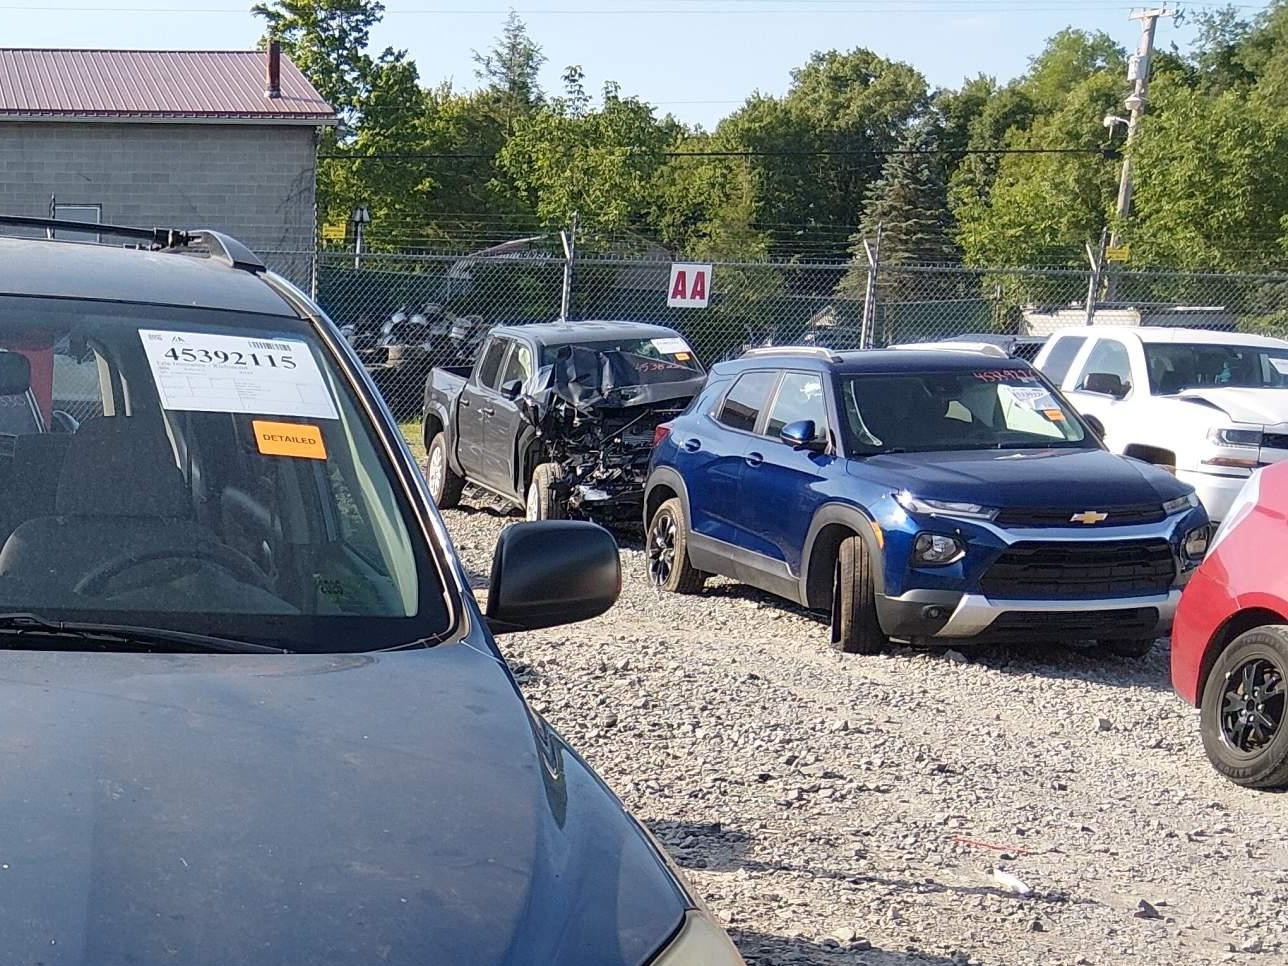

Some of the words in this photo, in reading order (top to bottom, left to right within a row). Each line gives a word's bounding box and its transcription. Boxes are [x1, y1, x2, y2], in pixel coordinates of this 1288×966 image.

[671, 271, 705, 299] AA
[164, 347, 297, 369] 45392115
[263, 434, 316, 445] DETAILED
